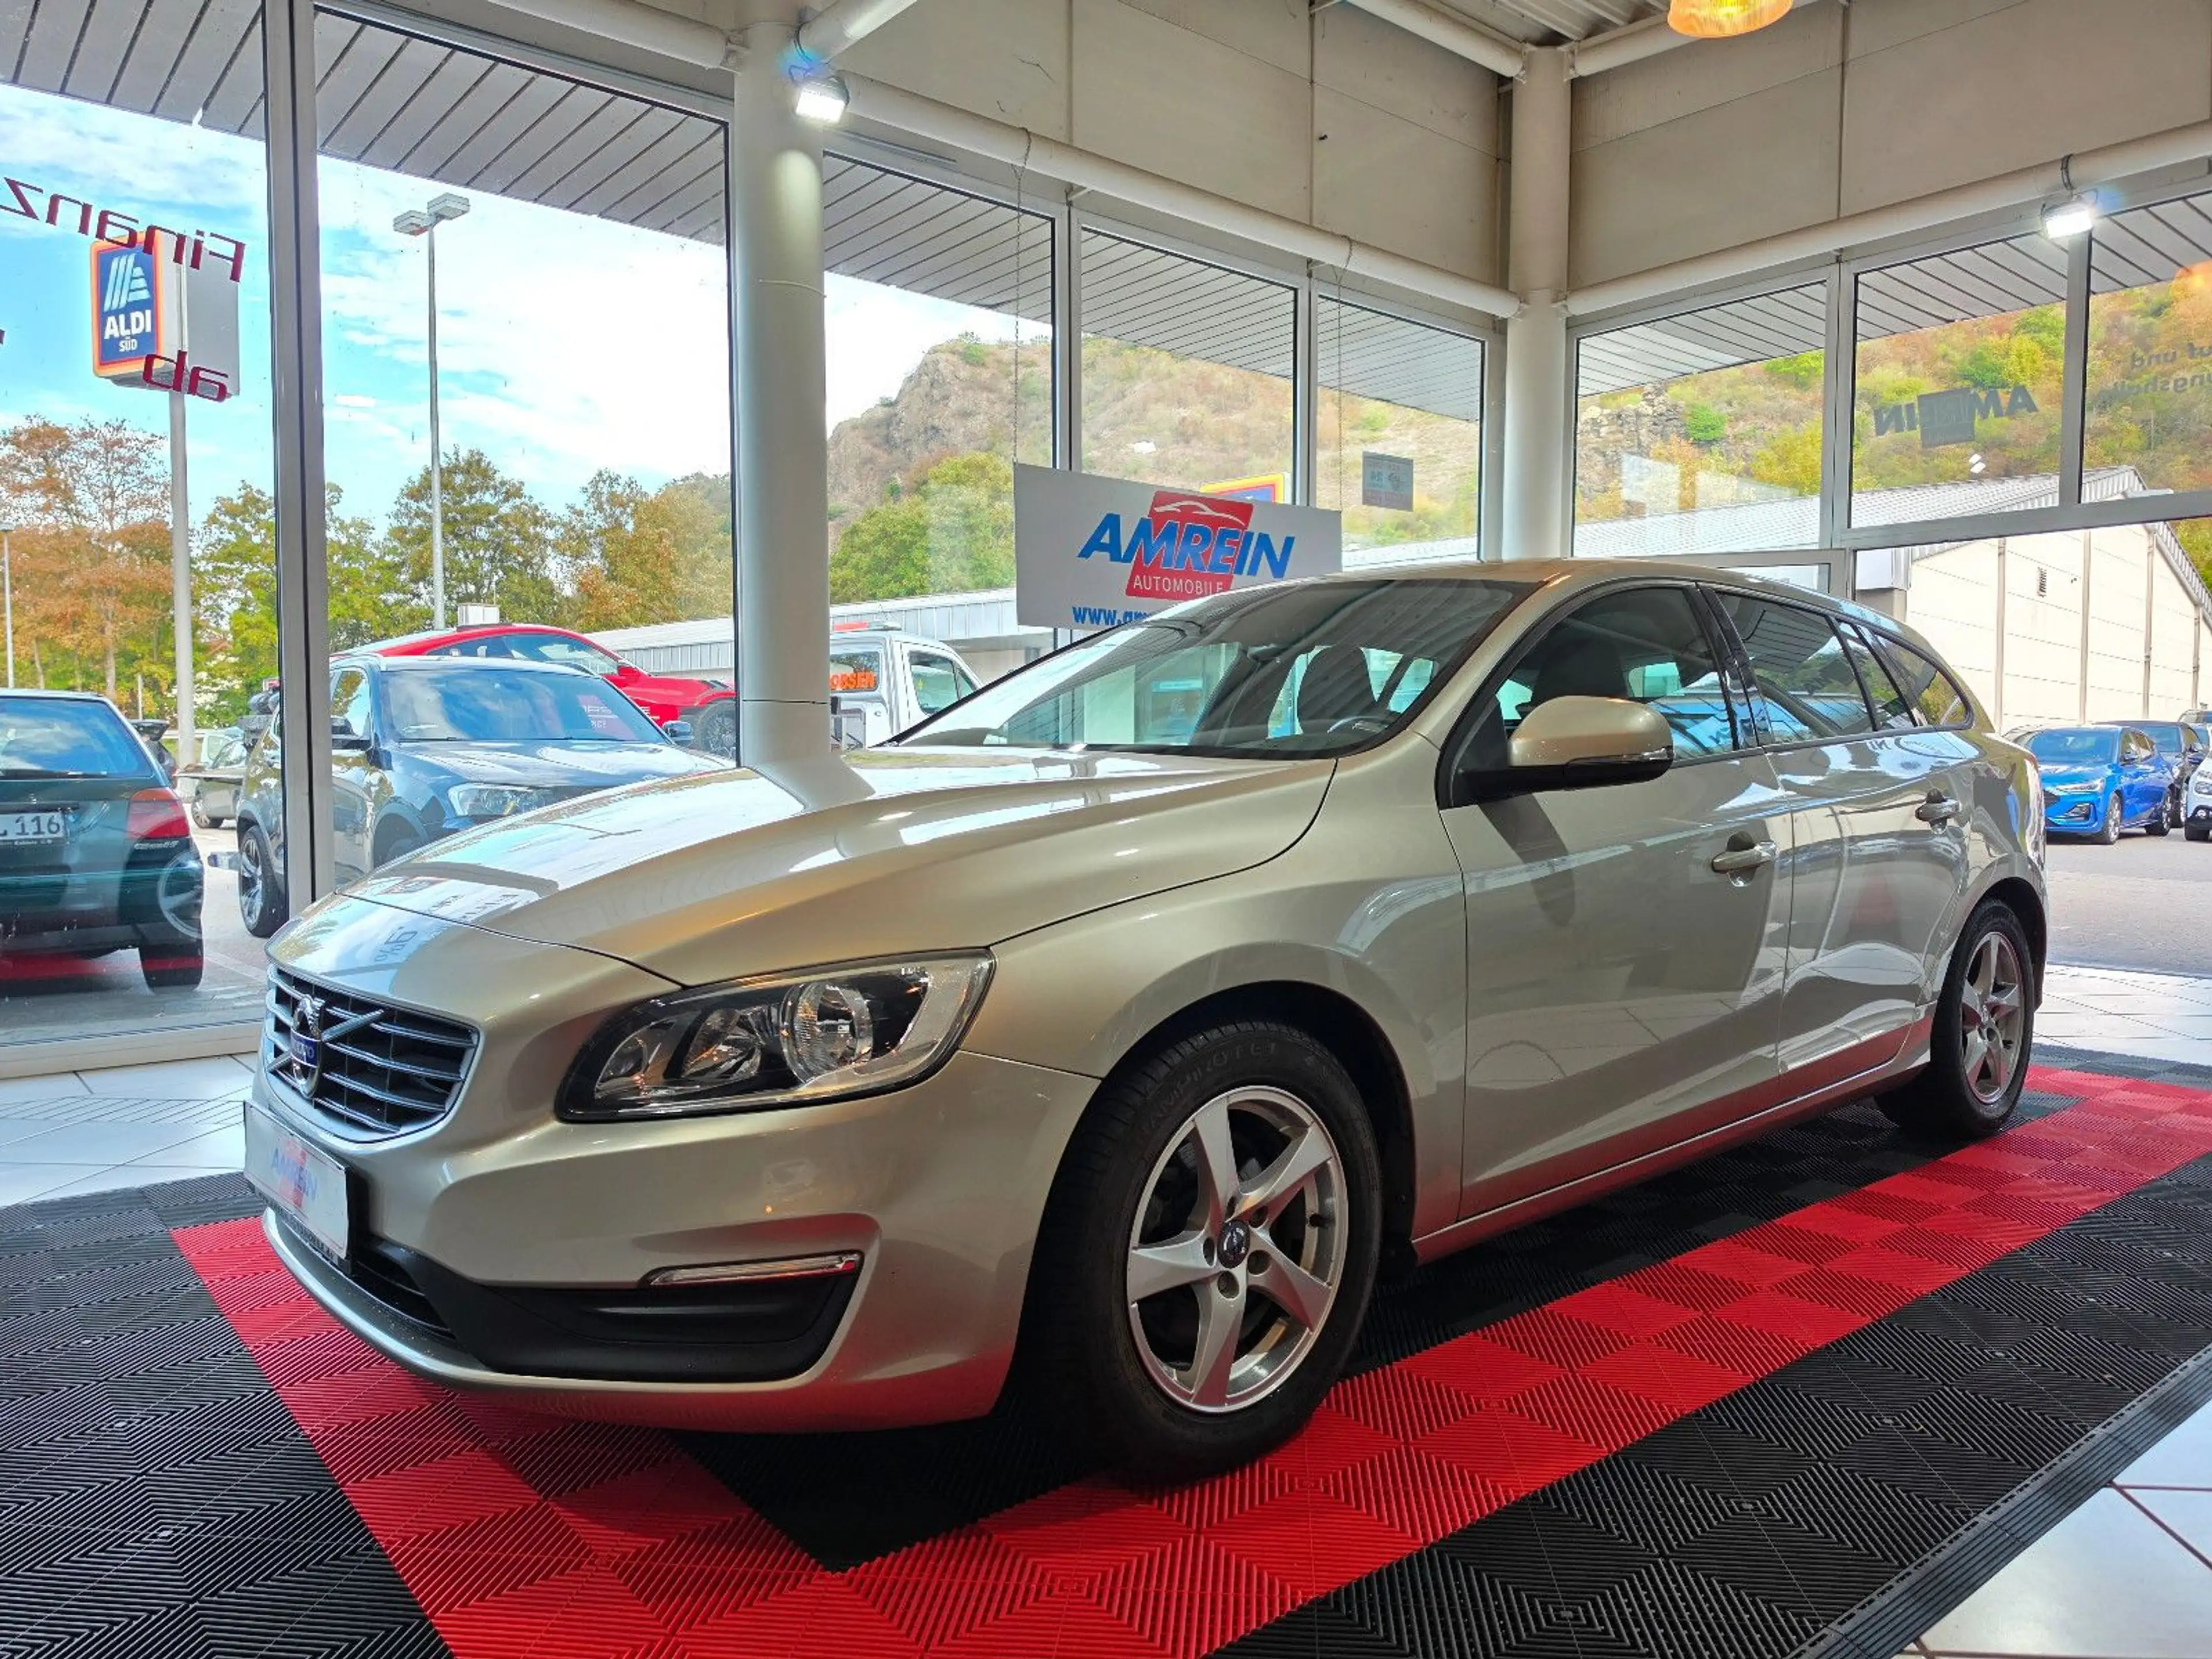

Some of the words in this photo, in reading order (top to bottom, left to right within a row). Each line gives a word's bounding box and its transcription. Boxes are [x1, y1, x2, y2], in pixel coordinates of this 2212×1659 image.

[104, 309, 151, 339] ALDI
[119, 337, 138, 352] SÜD
[1078, 513, 1295, 580] AMREIN
[15, 816, 60, 835] 116
